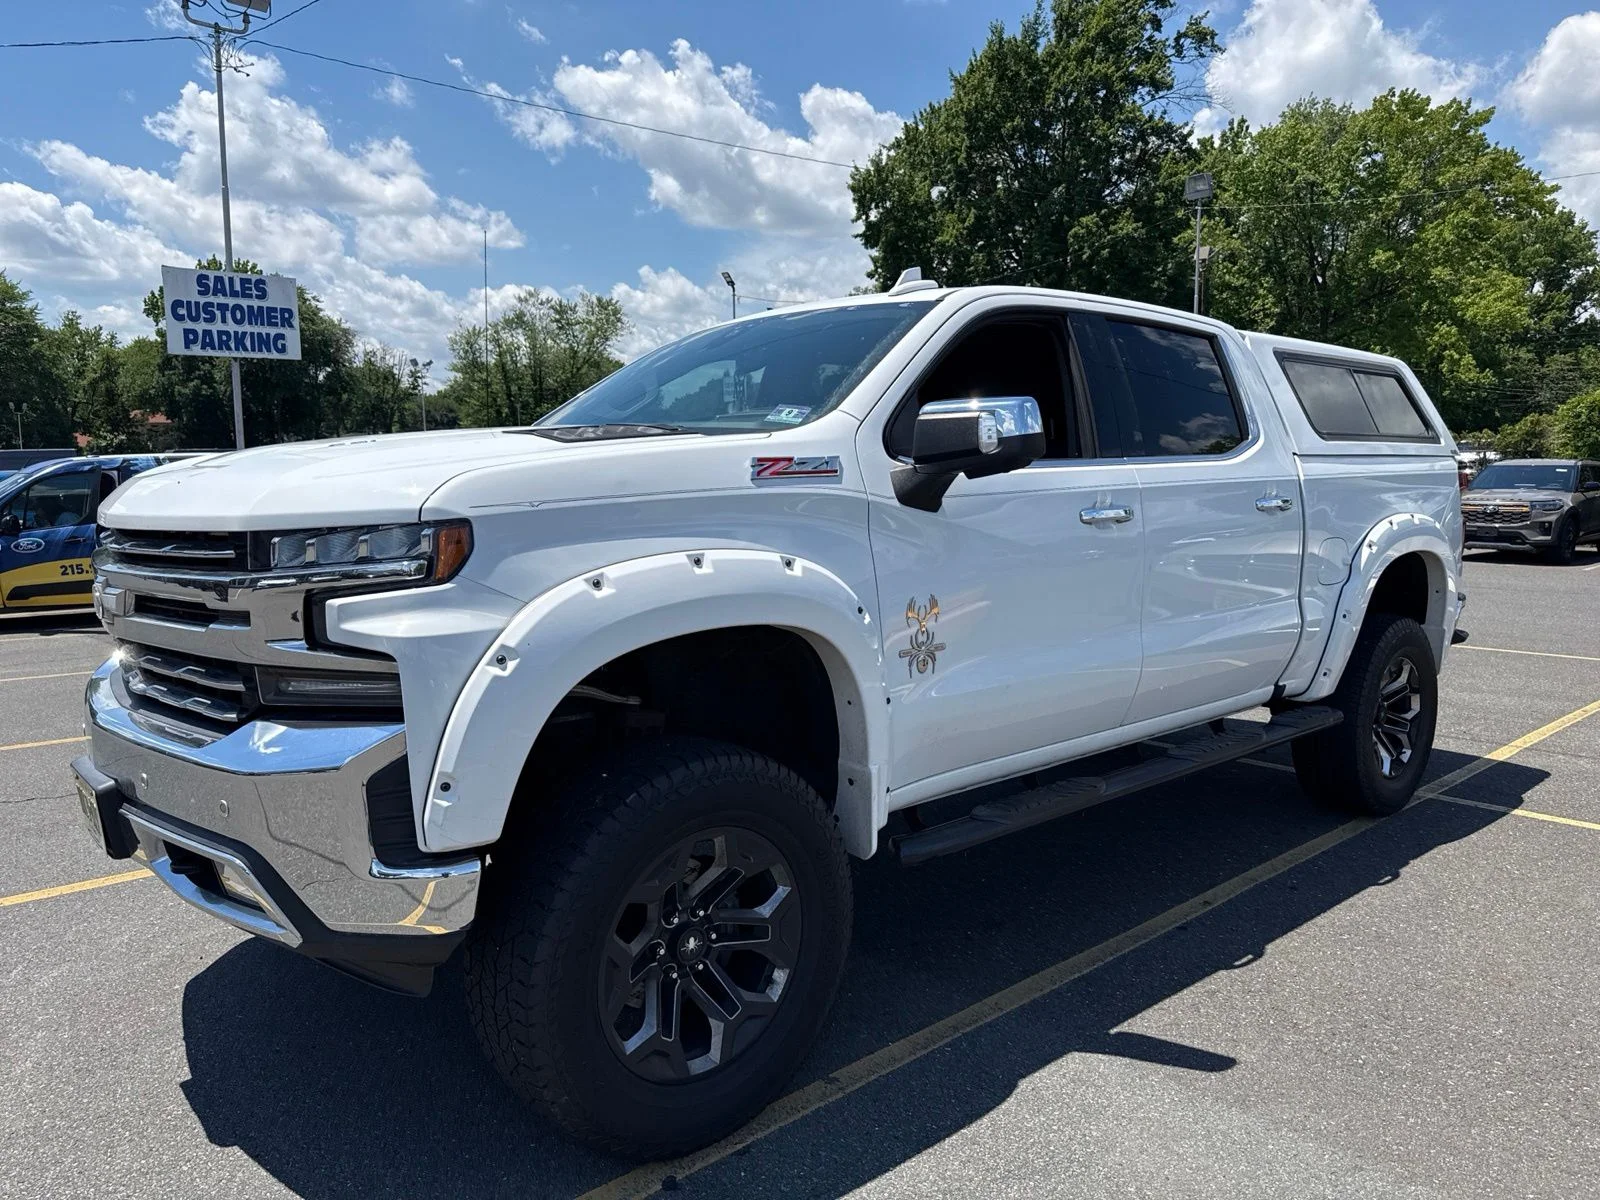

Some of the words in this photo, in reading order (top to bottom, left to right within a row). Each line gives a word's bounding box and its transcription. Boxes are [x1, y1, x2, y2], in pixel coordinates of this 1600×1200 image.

[196, 274, 268, 300] SALES
[171, 299, 295, 328] CUSTOMER
[183, 328, 287, 353] PARKING
[756, 455, 840, 477] Z71
[59, 564, 92, 576] 215.
